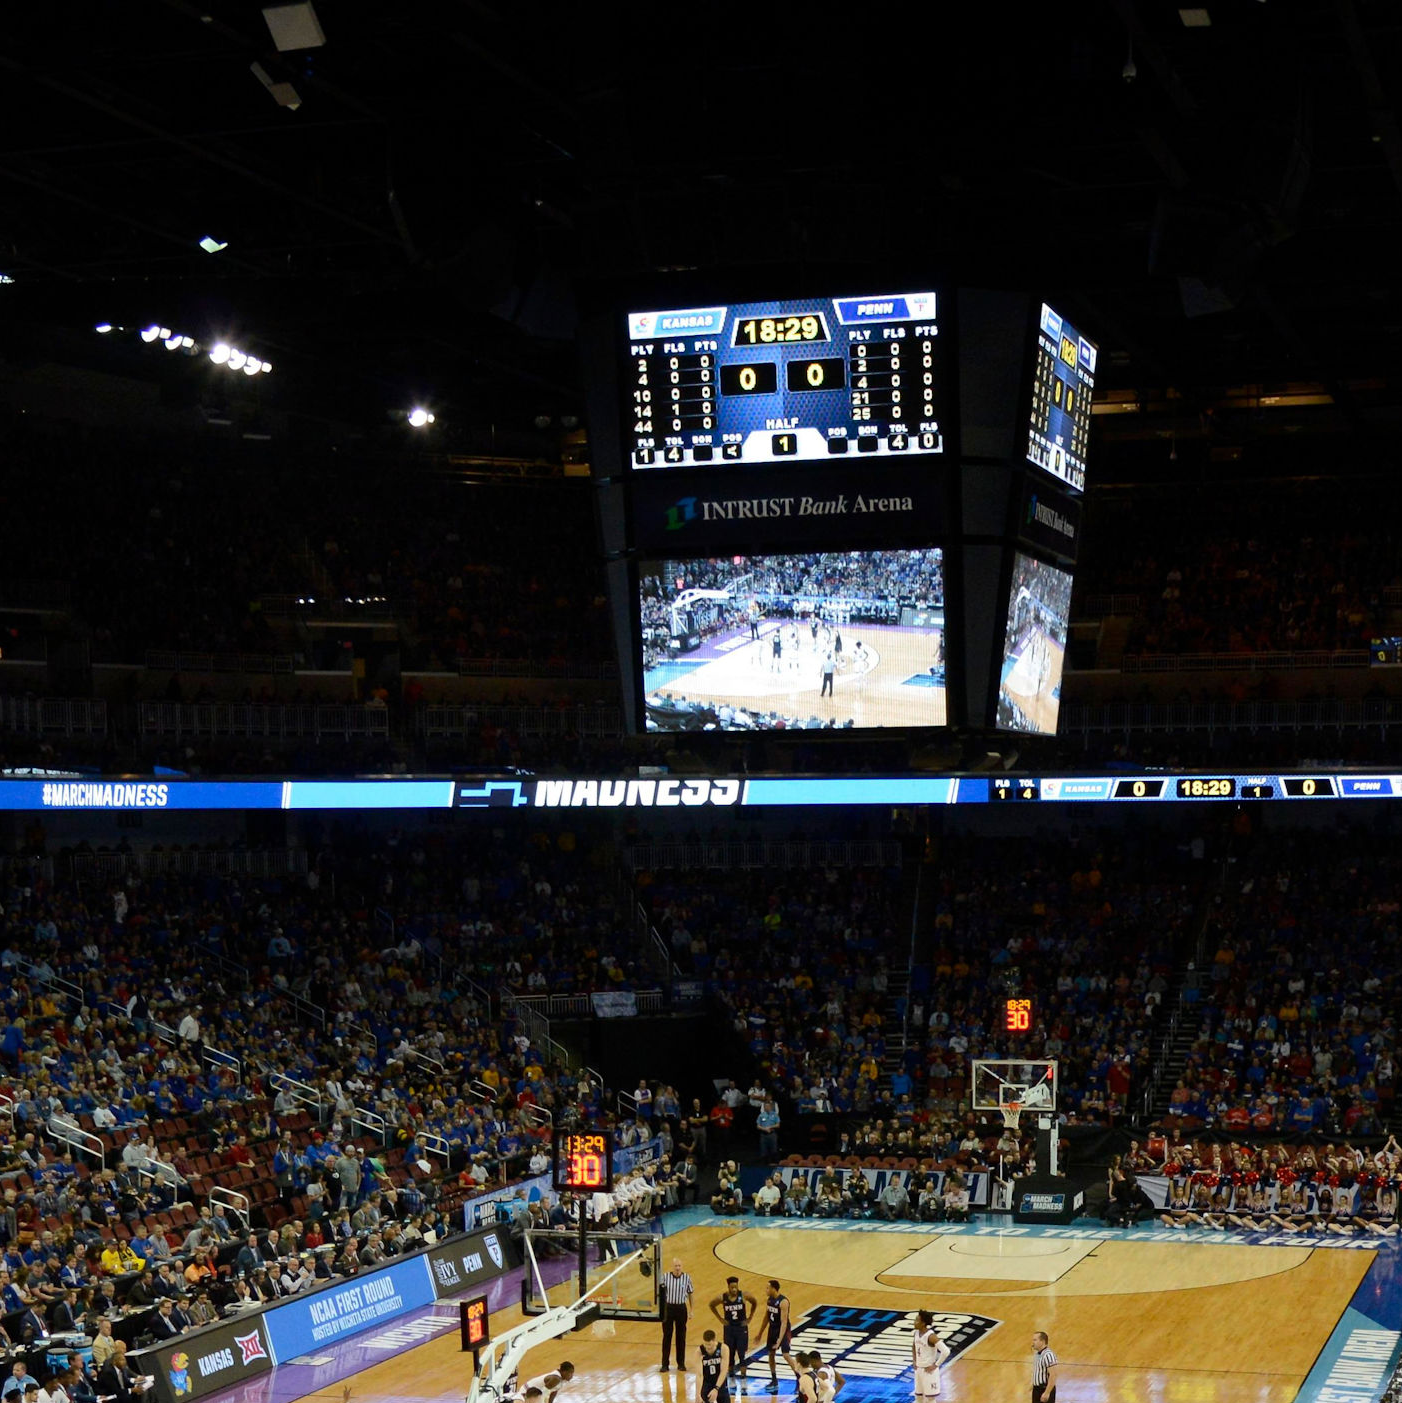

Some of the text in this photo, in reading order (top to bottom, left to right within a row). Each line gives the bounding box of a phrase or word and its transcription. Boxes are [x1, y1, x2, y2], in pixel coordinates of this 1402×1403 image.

[857, 303, 894, 315] PENN
[662, 315, 713, 330] KANSAS
[744, 316, 818, 344] 18:29
[849, 330, 871, 341] PLY
[915, 326, 938, 337] PTS
[631, 345, 654, 356] PLY
[857, 341, 932, 357] 0 0 0
[638, 355, 709, 372] 2 0 0
[858, 355, 932, 372] 2 0 0
[638, 369, 710, 385] 4 0 0
[739, 367, 756, 390] 0
[806, 363, 824, 386] 0
[857, 372, 932, 388] 4 0 0
[633, 386, 711, 402] 10 0 0
[852, 388, 933, 405] 21 0 0
[634, 401, 711, 418] 14 1 0
[852, 404, 933, 420] 25 0 0
[634, 417, 712, 433] 44 0 0
[766, 417, 799, 430] HALF
[779, 435, 789, 452] 1
[892, 433, 934, 449] 4 0
[640, 447, 680, 463] 1 4
[703, 494, 913, 521] INTRUST Bank Arena
[42, 783, 169, 807] #MARCHMADNESS
[998, 789, 1032, 799] 1 4
[1132, 781, 1146, 797] 0
[1181, 780, 1231, 797] 18:29
[1302, 779, 1316, 795] 0
[1253, 787, 1260, 798] 1
[1007, 1010, 1029, 1030] 30
[1030, 1195, 1053, 1203] MARCH
[1032, 1202, 1063, 1211] MADNESS
[767, 1219, 1382, 1249] THE ROAD TO THE FINAL FOUR
[462, 1251, 483, 1274] PENN
[309, 1275, 395, 1326] NCAA FIRST ROUND
[331, 1321, 341, 1334] BY
[361, 1306, 377, 1322] STATE
[375, 1295, 403, 1317] UNIVERSITY
[732, 1311, 738, 1320] 2
[1340, 1329, 1402, 1361] ARENA
[197, 1347, 235, 1377] KANSAS
[702, 1357, 721, 1366] PENN
[1325, 1358, 1389, 1389] BANK
